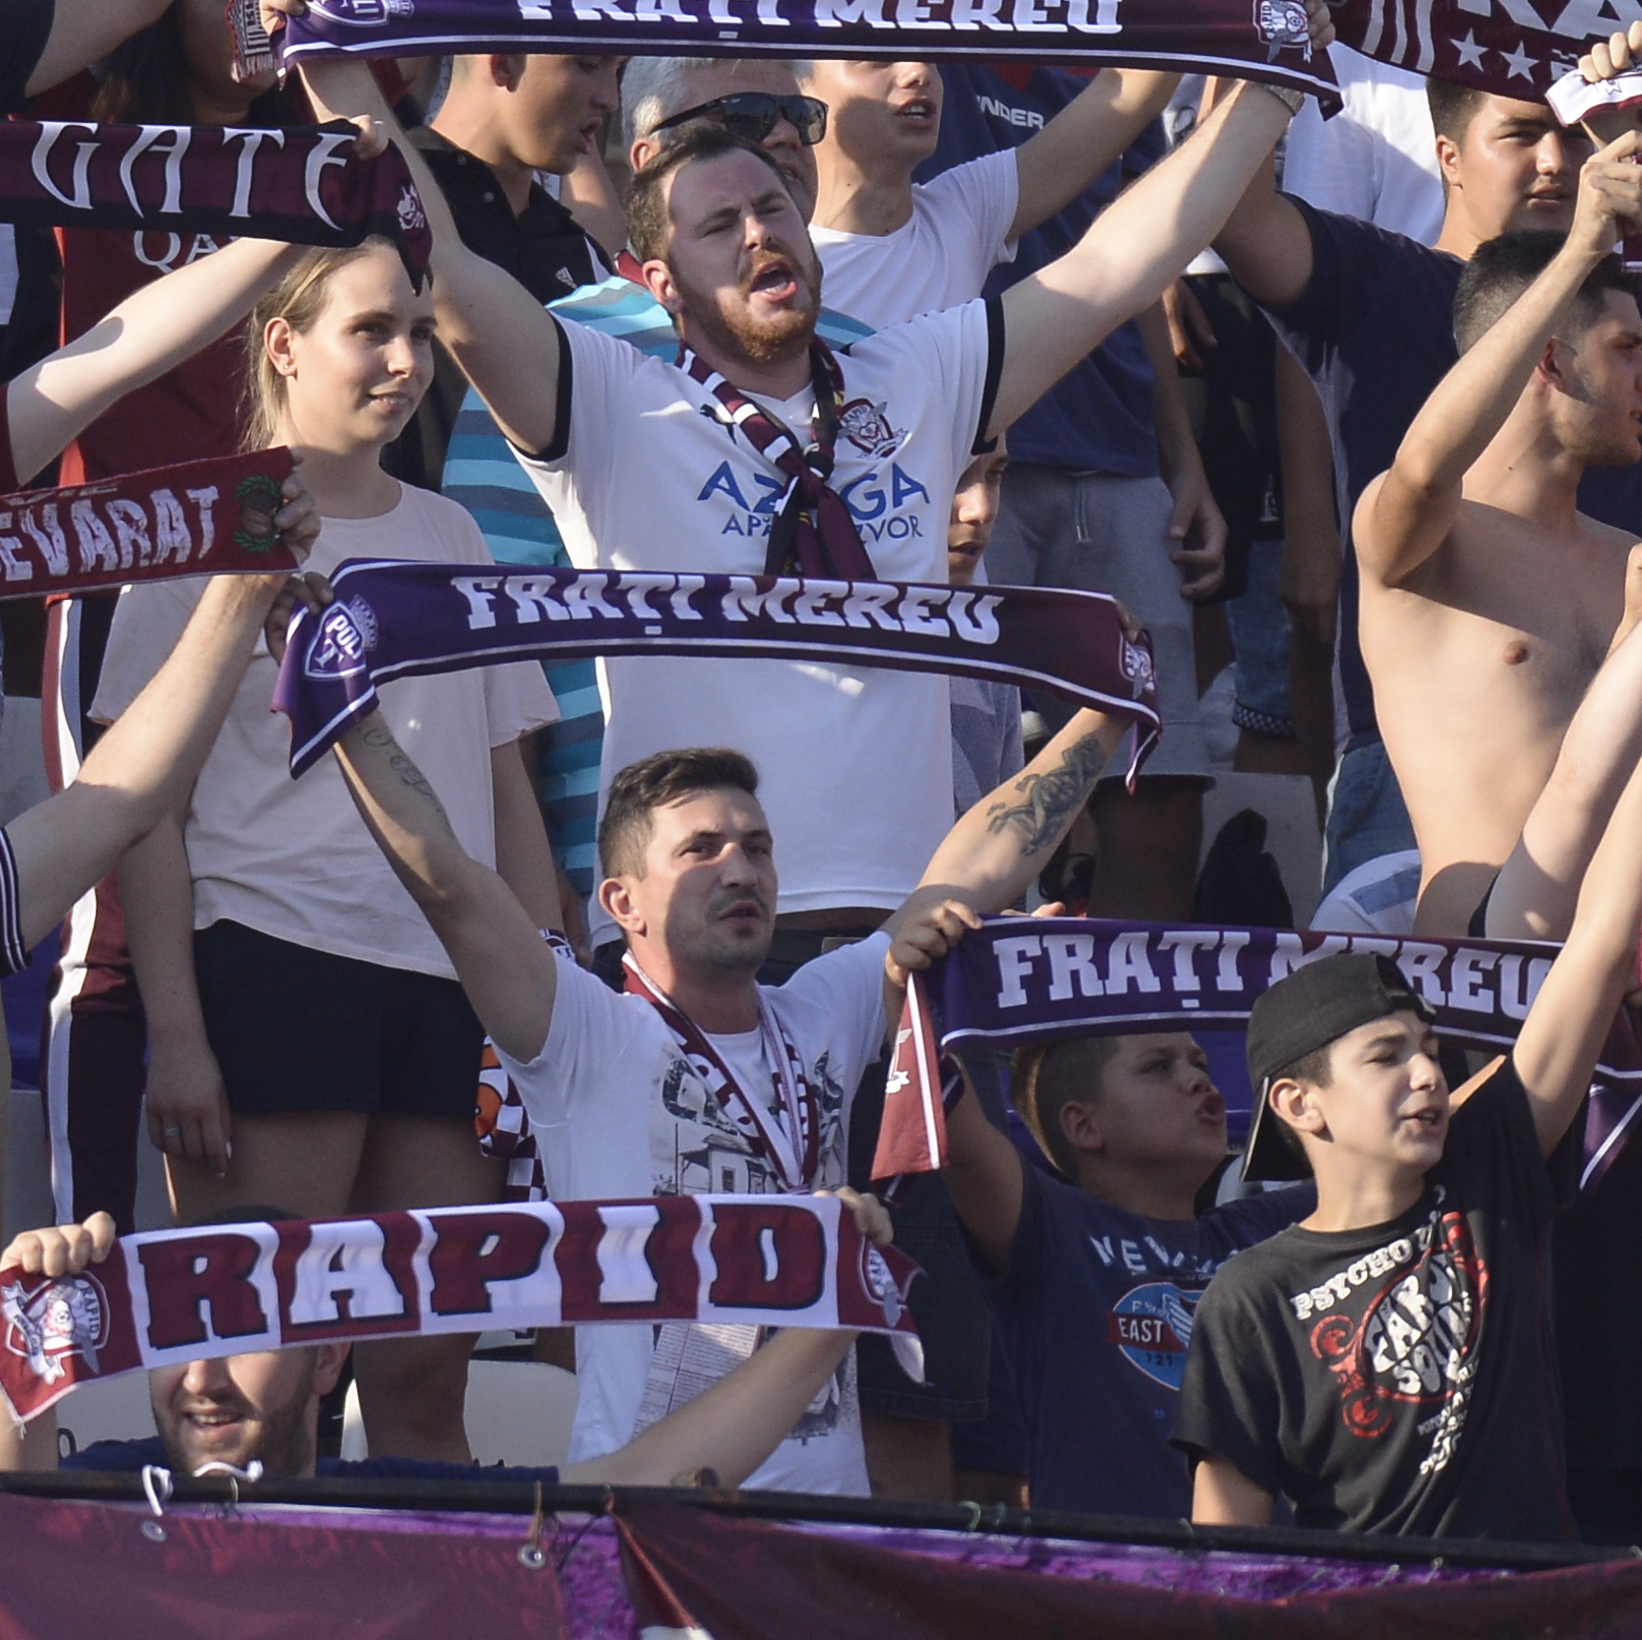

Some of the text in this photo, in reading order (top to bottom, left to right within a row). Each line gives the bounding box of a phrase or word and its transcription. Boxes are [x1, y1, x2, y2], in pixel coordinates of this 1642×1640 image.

[979, 96, 1044, 129] NDER
[31, 121, 358, 229] GATE
[722, 575, 1005, 647] MEREU
[138, 1204, 827, 1350] RAPID
[1290, 1237, 1414, 1322] PSYCHO
[1118, 1317, 1165, 1345] EAST
